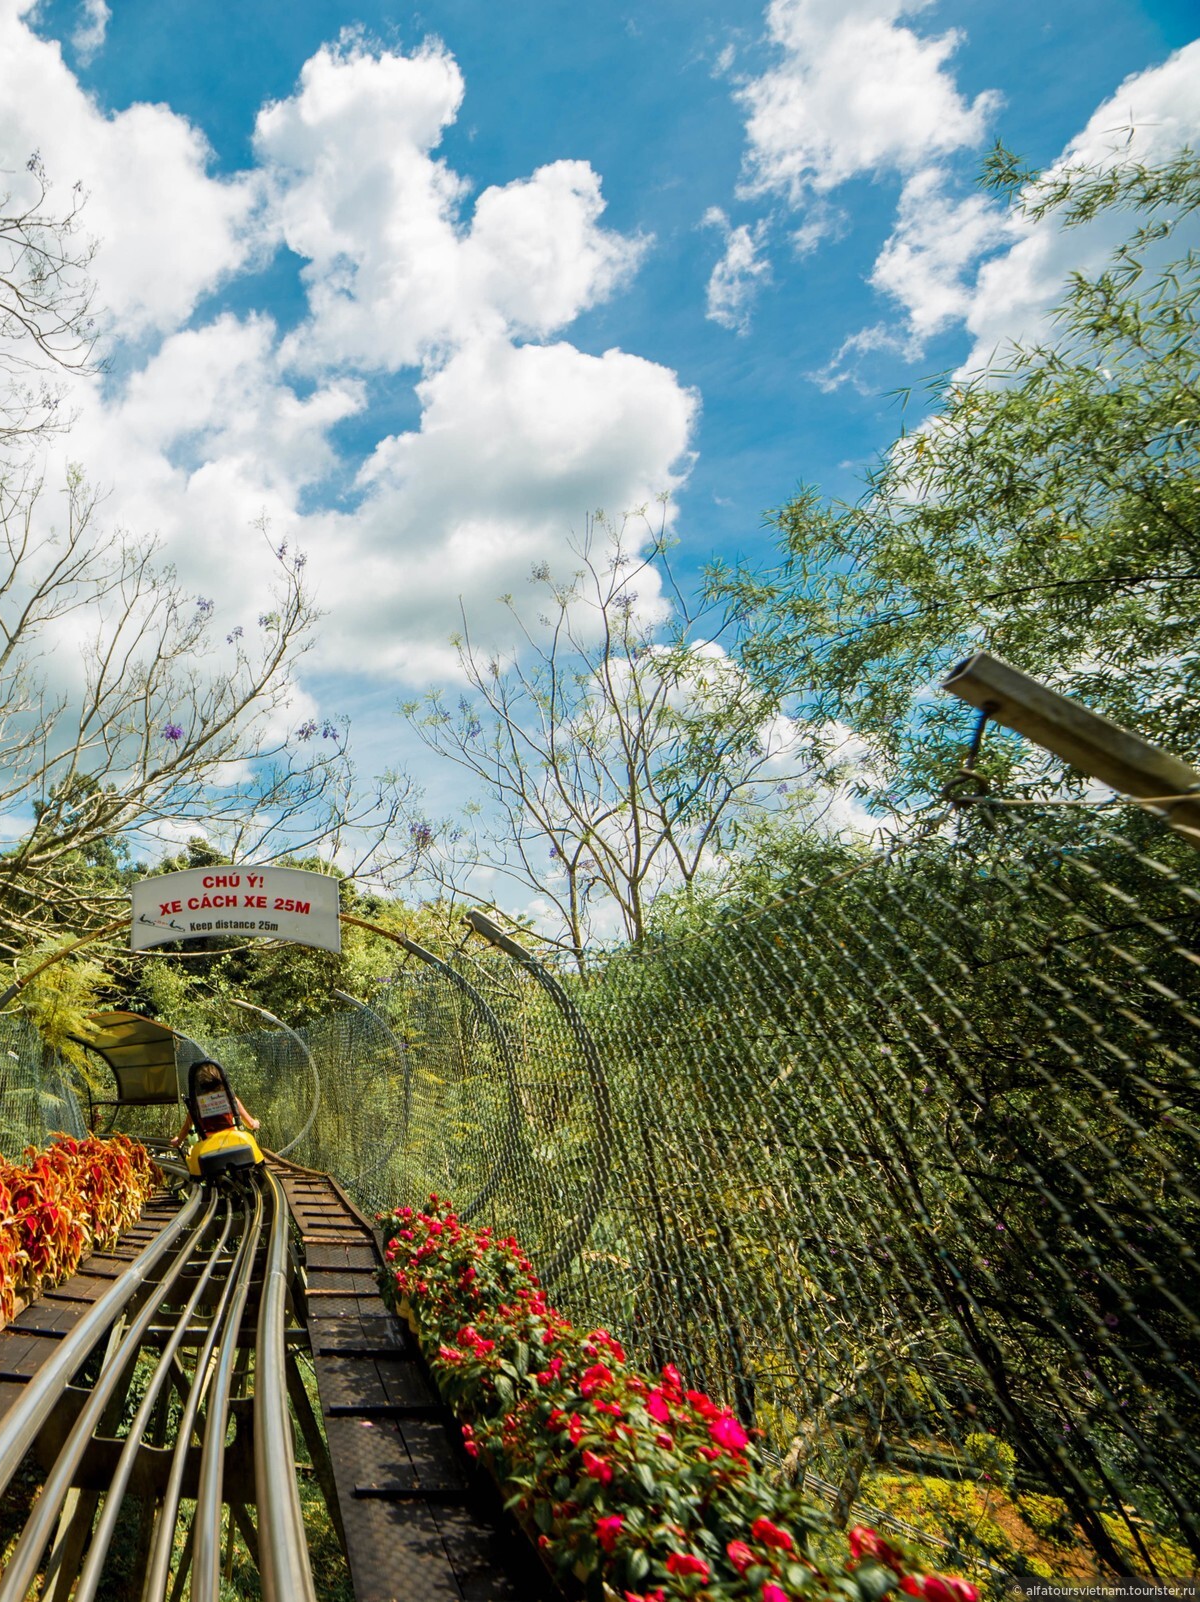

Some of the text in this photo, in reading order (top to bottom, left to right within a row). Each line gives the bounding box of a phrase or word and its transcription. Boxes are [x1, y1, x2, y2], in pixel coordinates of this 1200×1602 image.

[202, 872, 264, 888] CHÚ Ý!
[159, 893, 311, 916] XE CÁCH XE 25M
[190, 919, 278, 932] Keep distance 25m
